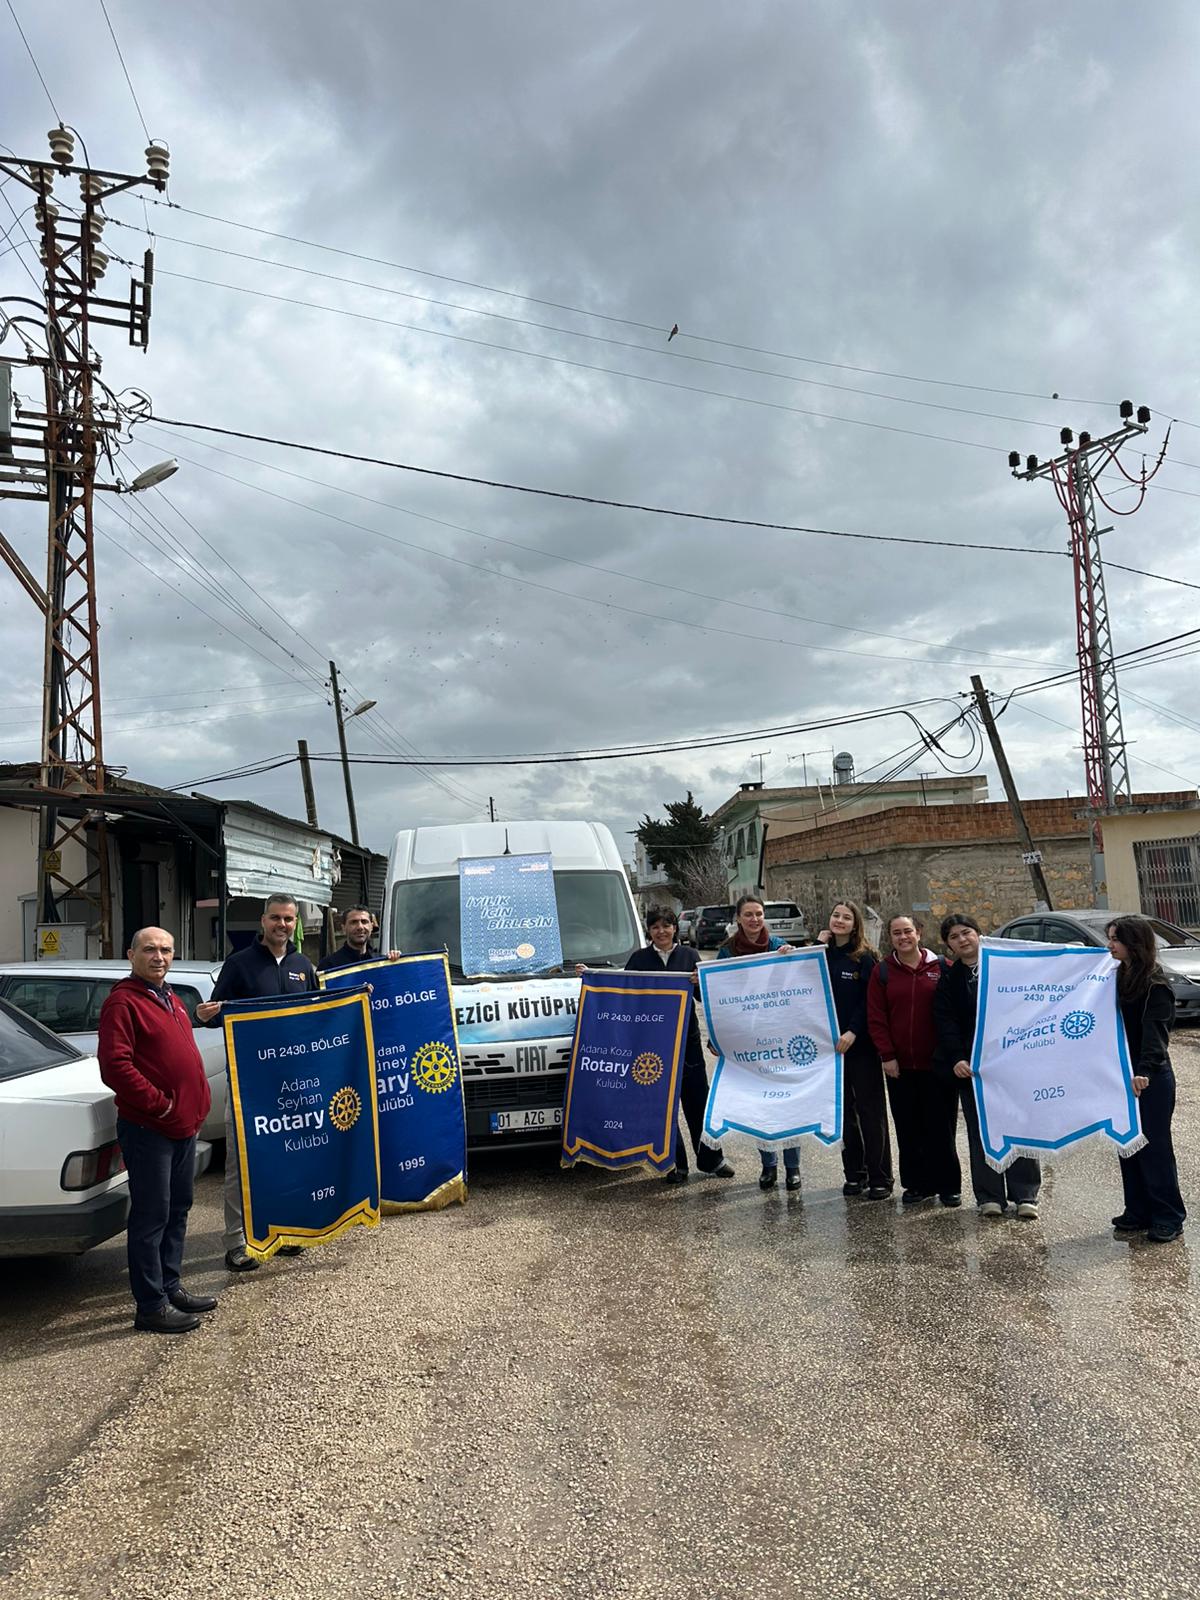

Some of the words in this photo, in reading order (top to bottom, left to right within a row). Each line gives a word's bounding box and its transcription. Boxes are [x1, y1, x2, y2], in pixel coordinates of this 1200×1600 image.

[371, 998, 393, 1011] 30.
[395, 990, 438, 1006] BÖLGE
[719, 991, 778, 1006] ULUSLARARASI
[779, 988, 813, 998] ROTARY
[507, 995, 579, 1020] KÜTÜPH
[597, 1012, 609, 1021] UR
[611, 1012, 633, 1023] 2430.
[634, 1012, 664, 1023] BÖLGE
[258, 1048, 277, 1061] UR
[279, 1043, 310, 1059] 2430.
[311, 1034, 350, 1053] BÖLGE
[377, 1044, 406, 1057] dana
[579, 1043, 608, 1055] Adana
[610, 1046, 633, 1058] Koza
[756, 1037, 783, 1047] Adana
[1023, 1037, 1055, 1050] Kulübü
[515, 1045, 548, 1074] FIAT
[733, 1046, 784, 1064] Interact
[580, 1056, 630, 1077] Rotary
[281, 1076, 321, 1094] Adana
[596, 1076, 627, 1089] Kulübü
[277, 1092, 323, 1111] Seyhan
[762, 1091, 792, 1099] 1995
[1033, 1086, 1065, 1102] 2025
[254, 1109, 325, 1136] Rotary
[498, 1113, 511, 1128] 01
[524, 1111, 545, 1126] AZG
[554, 1109, 563, 1124] 6
[603, 1120, 623, 1130] 2024
[284, 1133, 330, 1153] Kulübü
[398, 1156, 426, 1172] 1995
[311, 1186, 336, 1202] 1976
